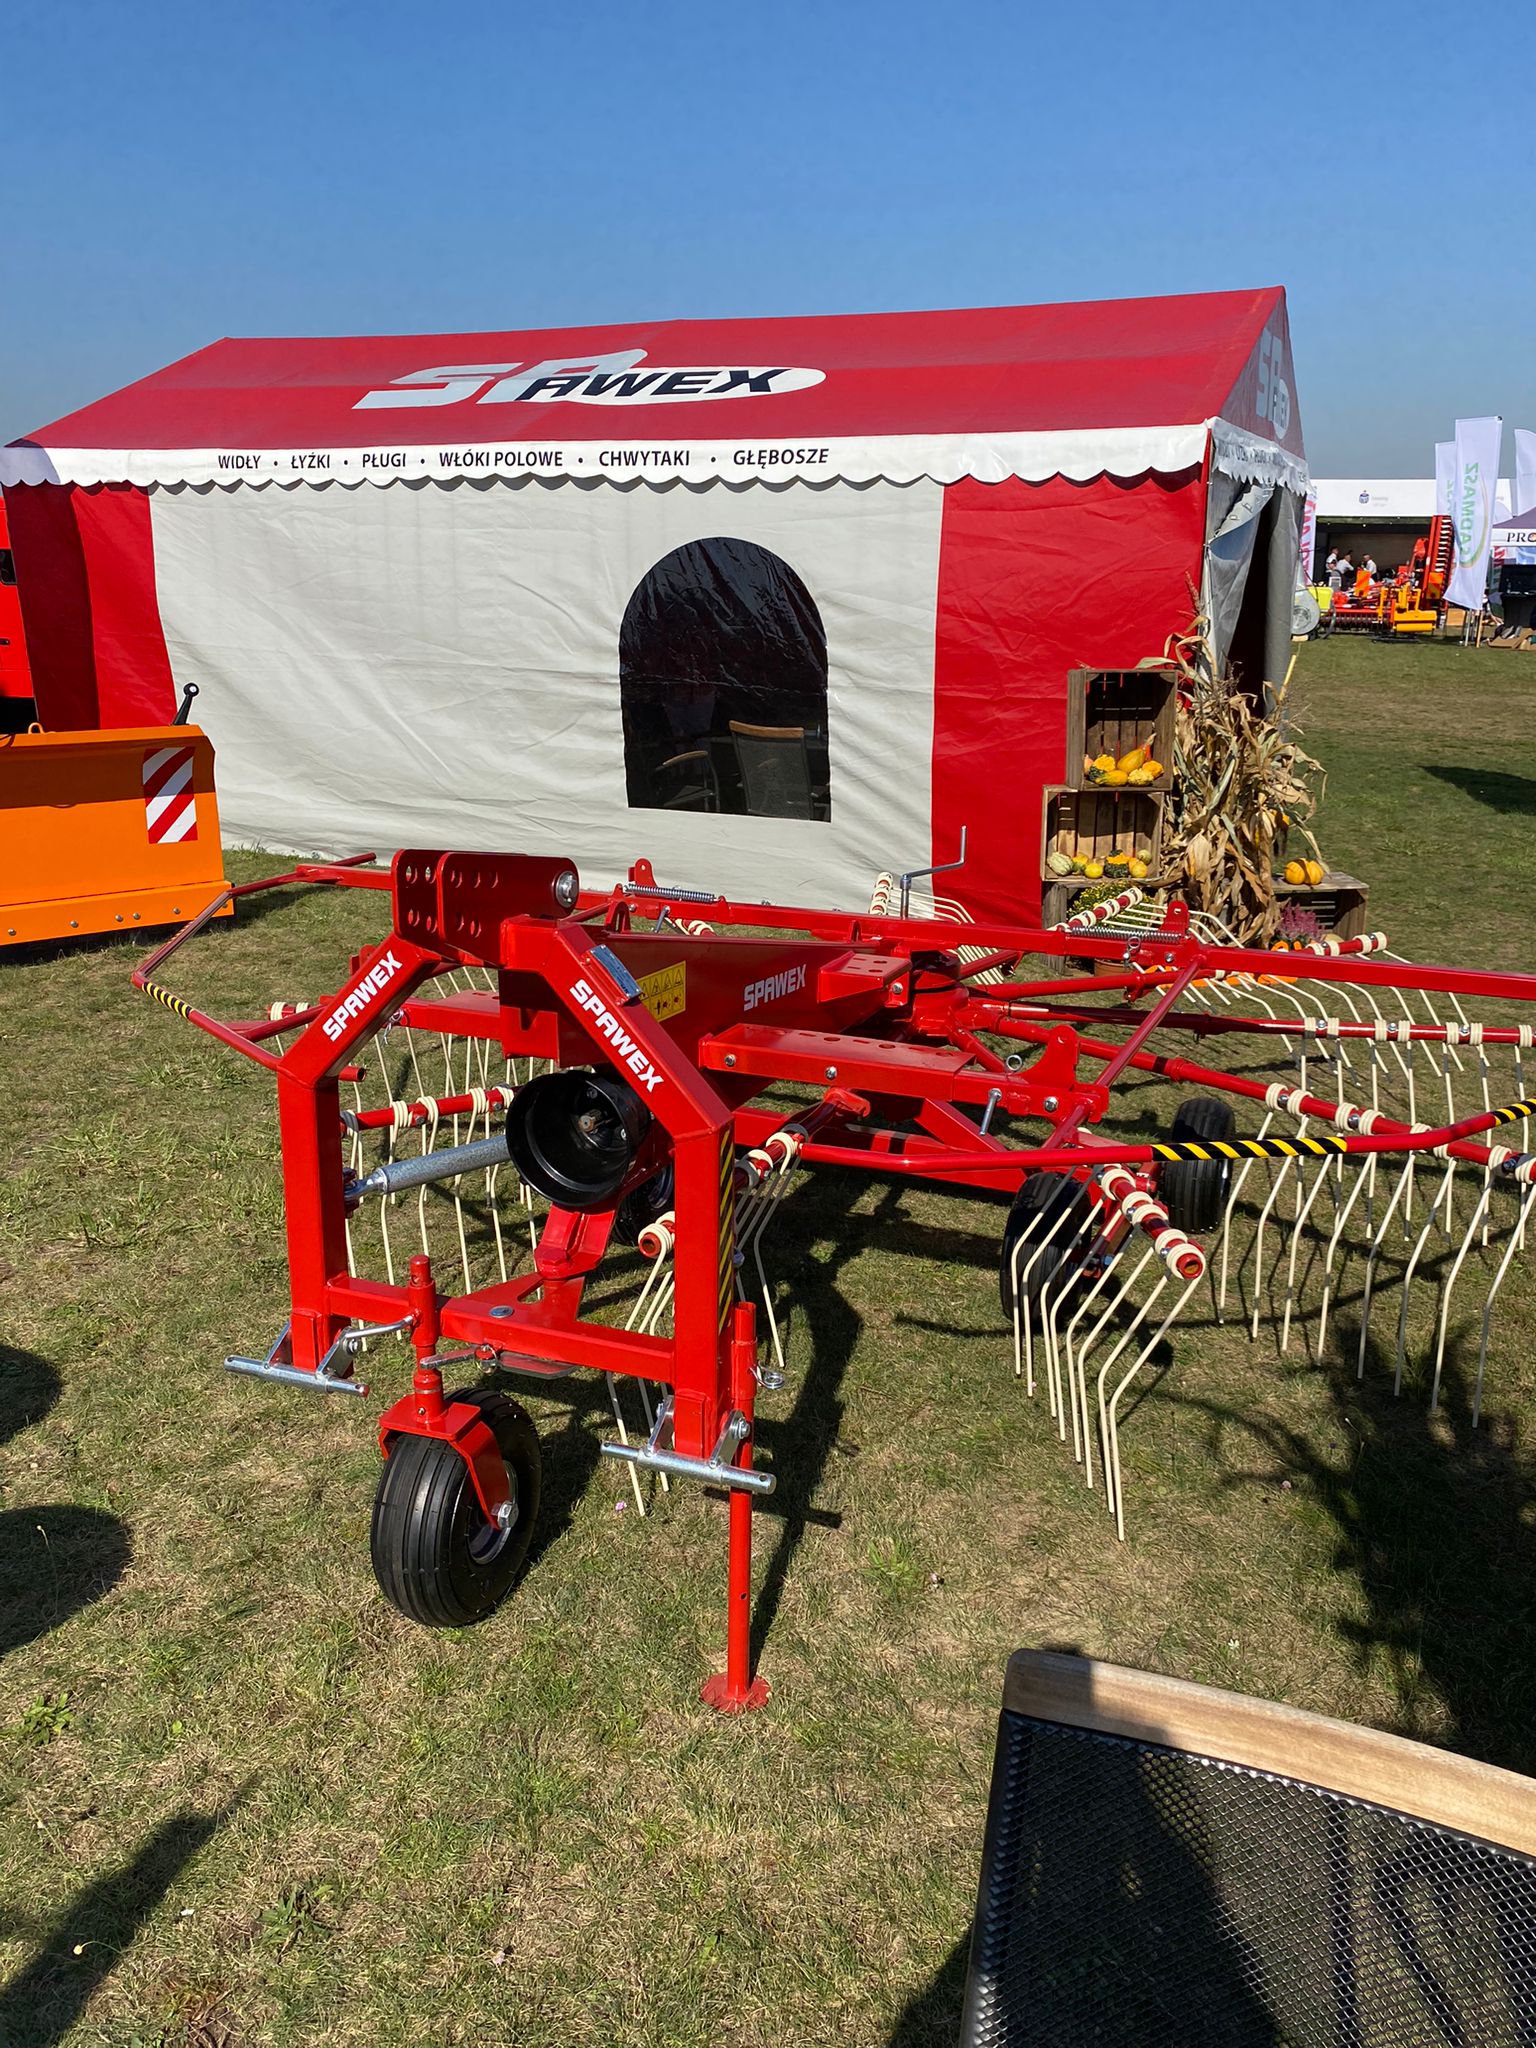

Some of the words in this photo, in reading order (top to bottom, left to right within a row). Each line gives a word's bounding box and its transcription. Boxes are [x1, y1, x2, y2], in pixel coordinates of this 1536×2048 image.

[217, 454, 261, 470] WIDŁY
[290, 452, 331, 470] ŁYŻKI
[362, 453, 407, 468] PŁUGI
[439, 449, 490, 467] WŁÓKI
[494, 450, 563, 467] POLOWE
[599, 449, 691, 467] CHWYTAKI
[733, 448, 829, 470] GŁĘBOSZE
[322, 950, 403, 1042] SPAWEX
[743, 964, 807, 1012] SPAWEX
[569, 978, 664, 1093] SPAWEX
